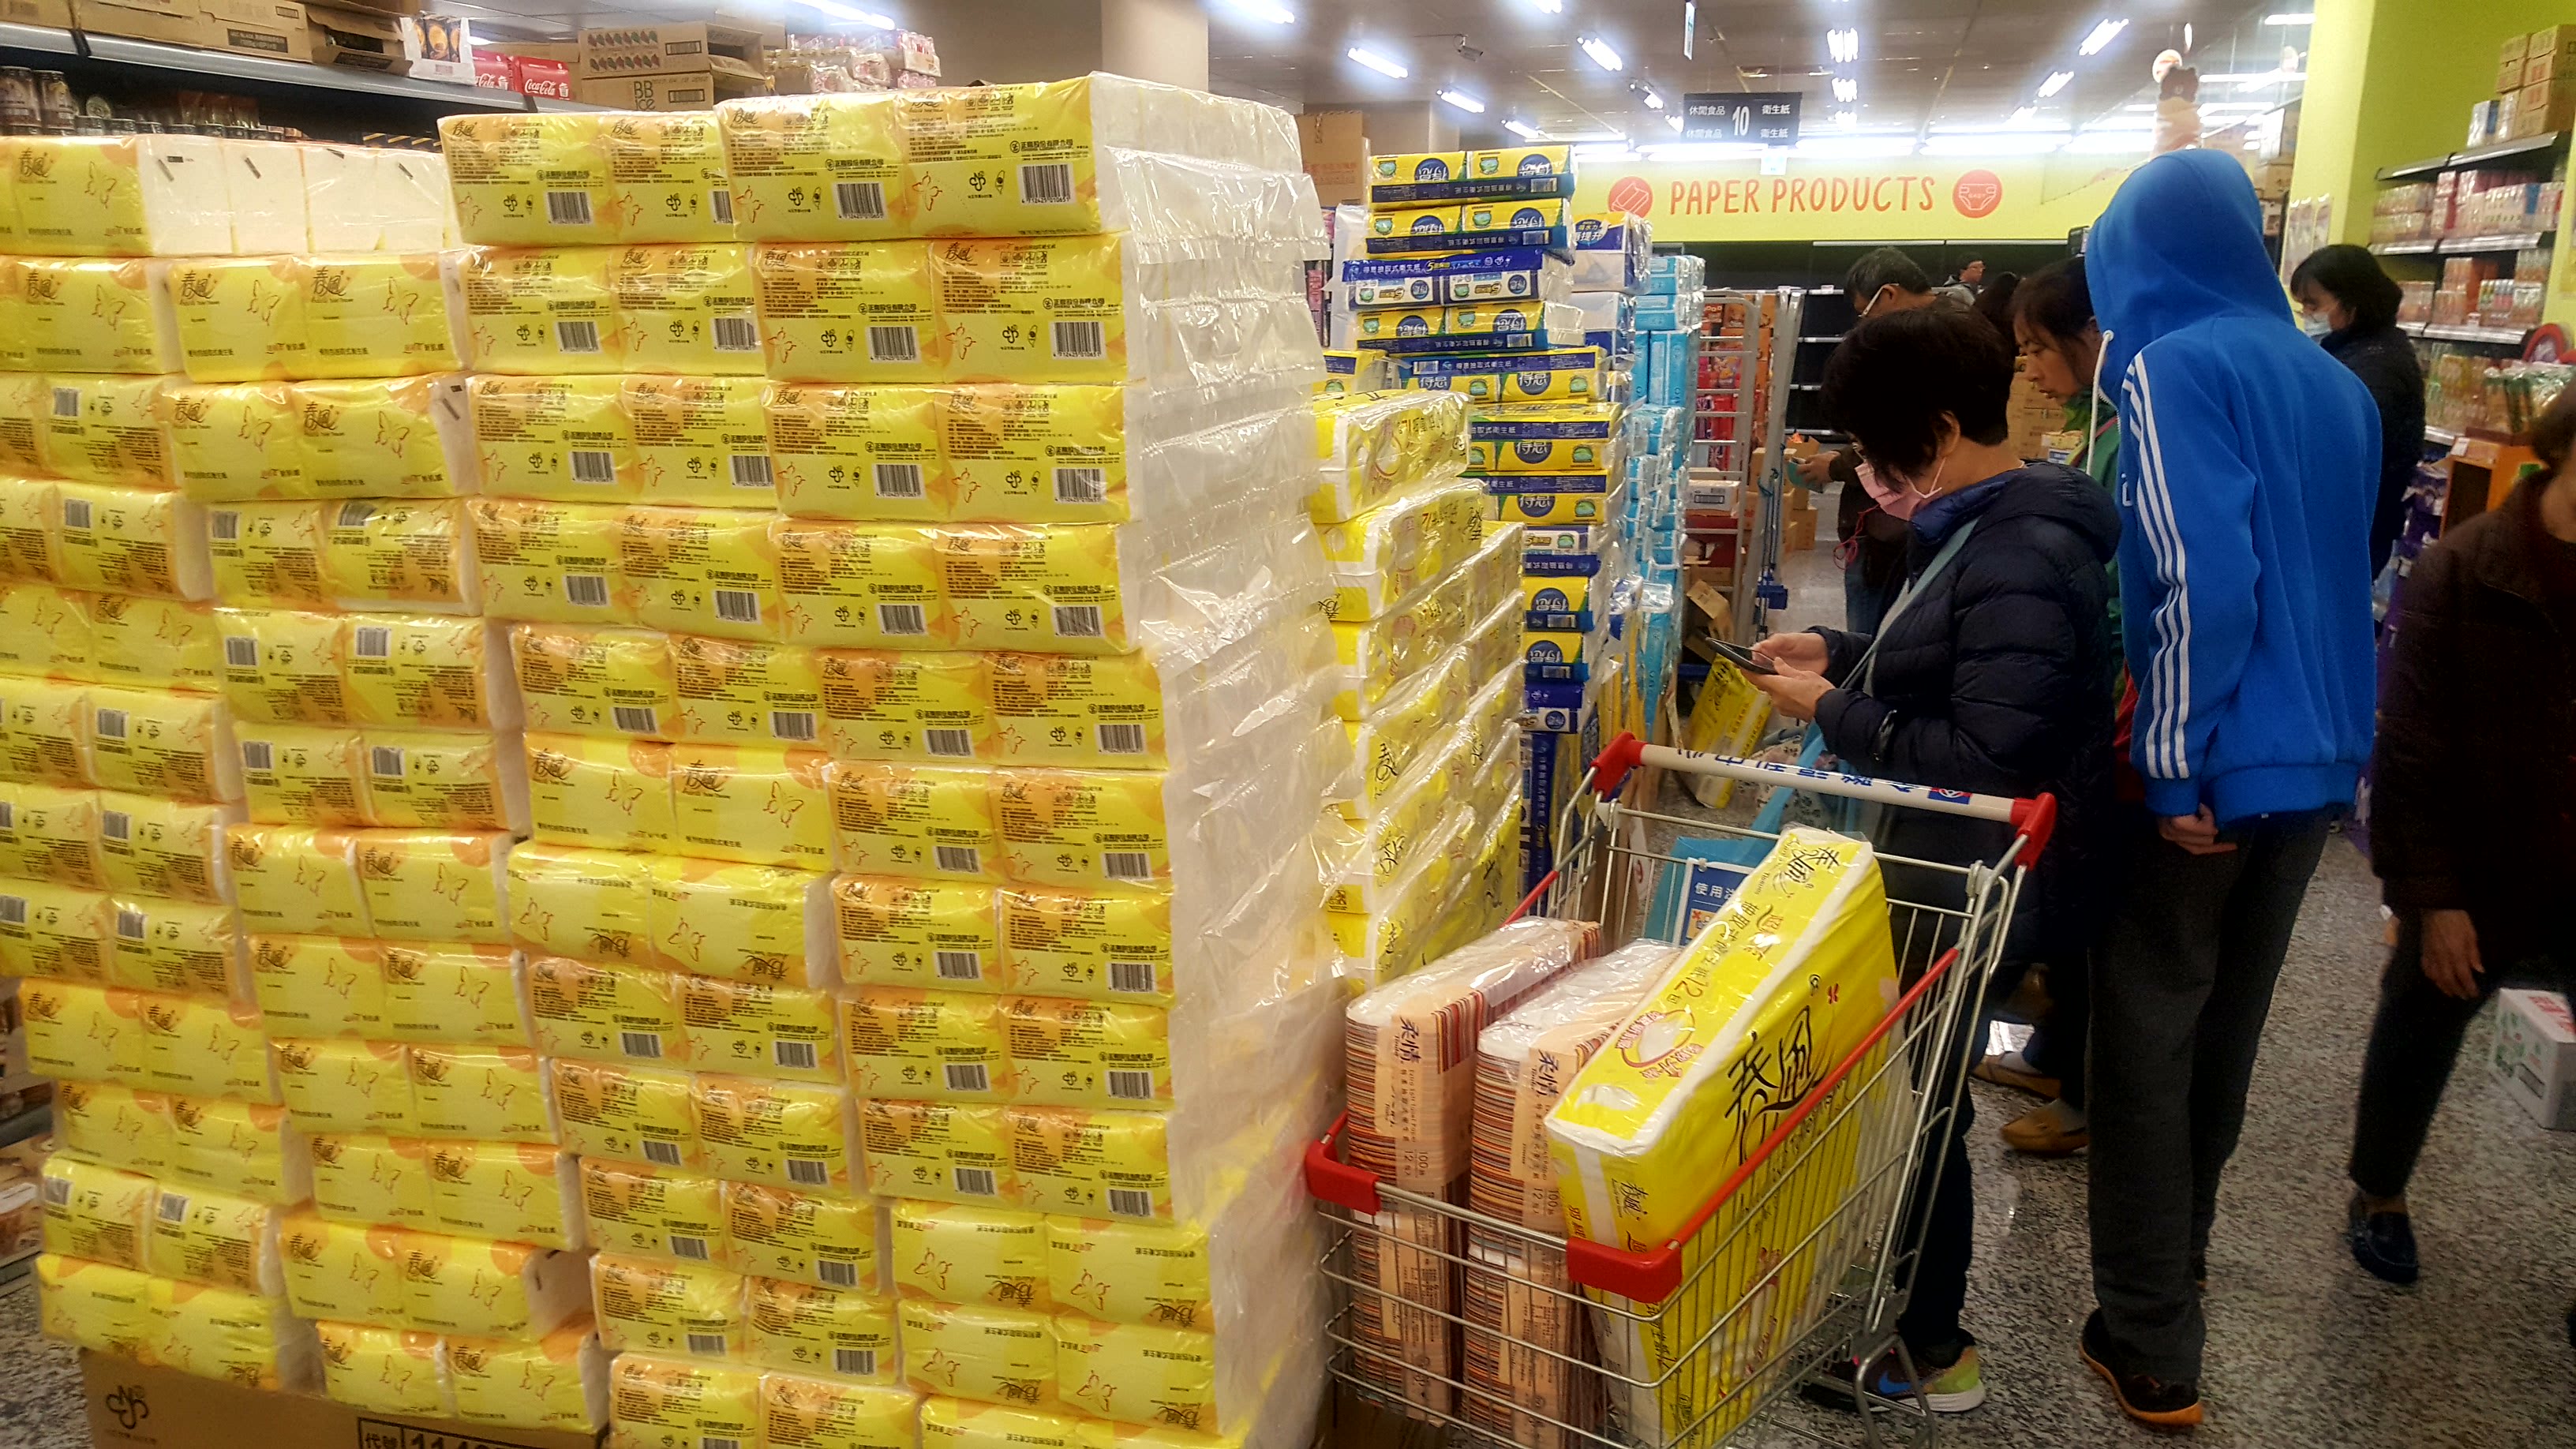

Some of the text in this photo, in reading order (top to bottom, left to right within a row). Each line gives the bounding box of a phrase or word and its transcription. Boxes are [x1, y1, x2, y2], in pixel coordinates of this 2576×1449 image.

[525, 78, 556, 95] Coca-Cola
[634, 81, 653, 98] BB
[1732, 106, 1750, 136] 10
[1762, 104, 1790, 114] 衛生紙
[1671, 176, 1934, 215] PAPER PRODUCTS
[1400, 1017, 1421, 1063] 柔情
[1536, 1049, 1559, 1097] 柔情
[1725, 1005, 1829, 1166] 春風
